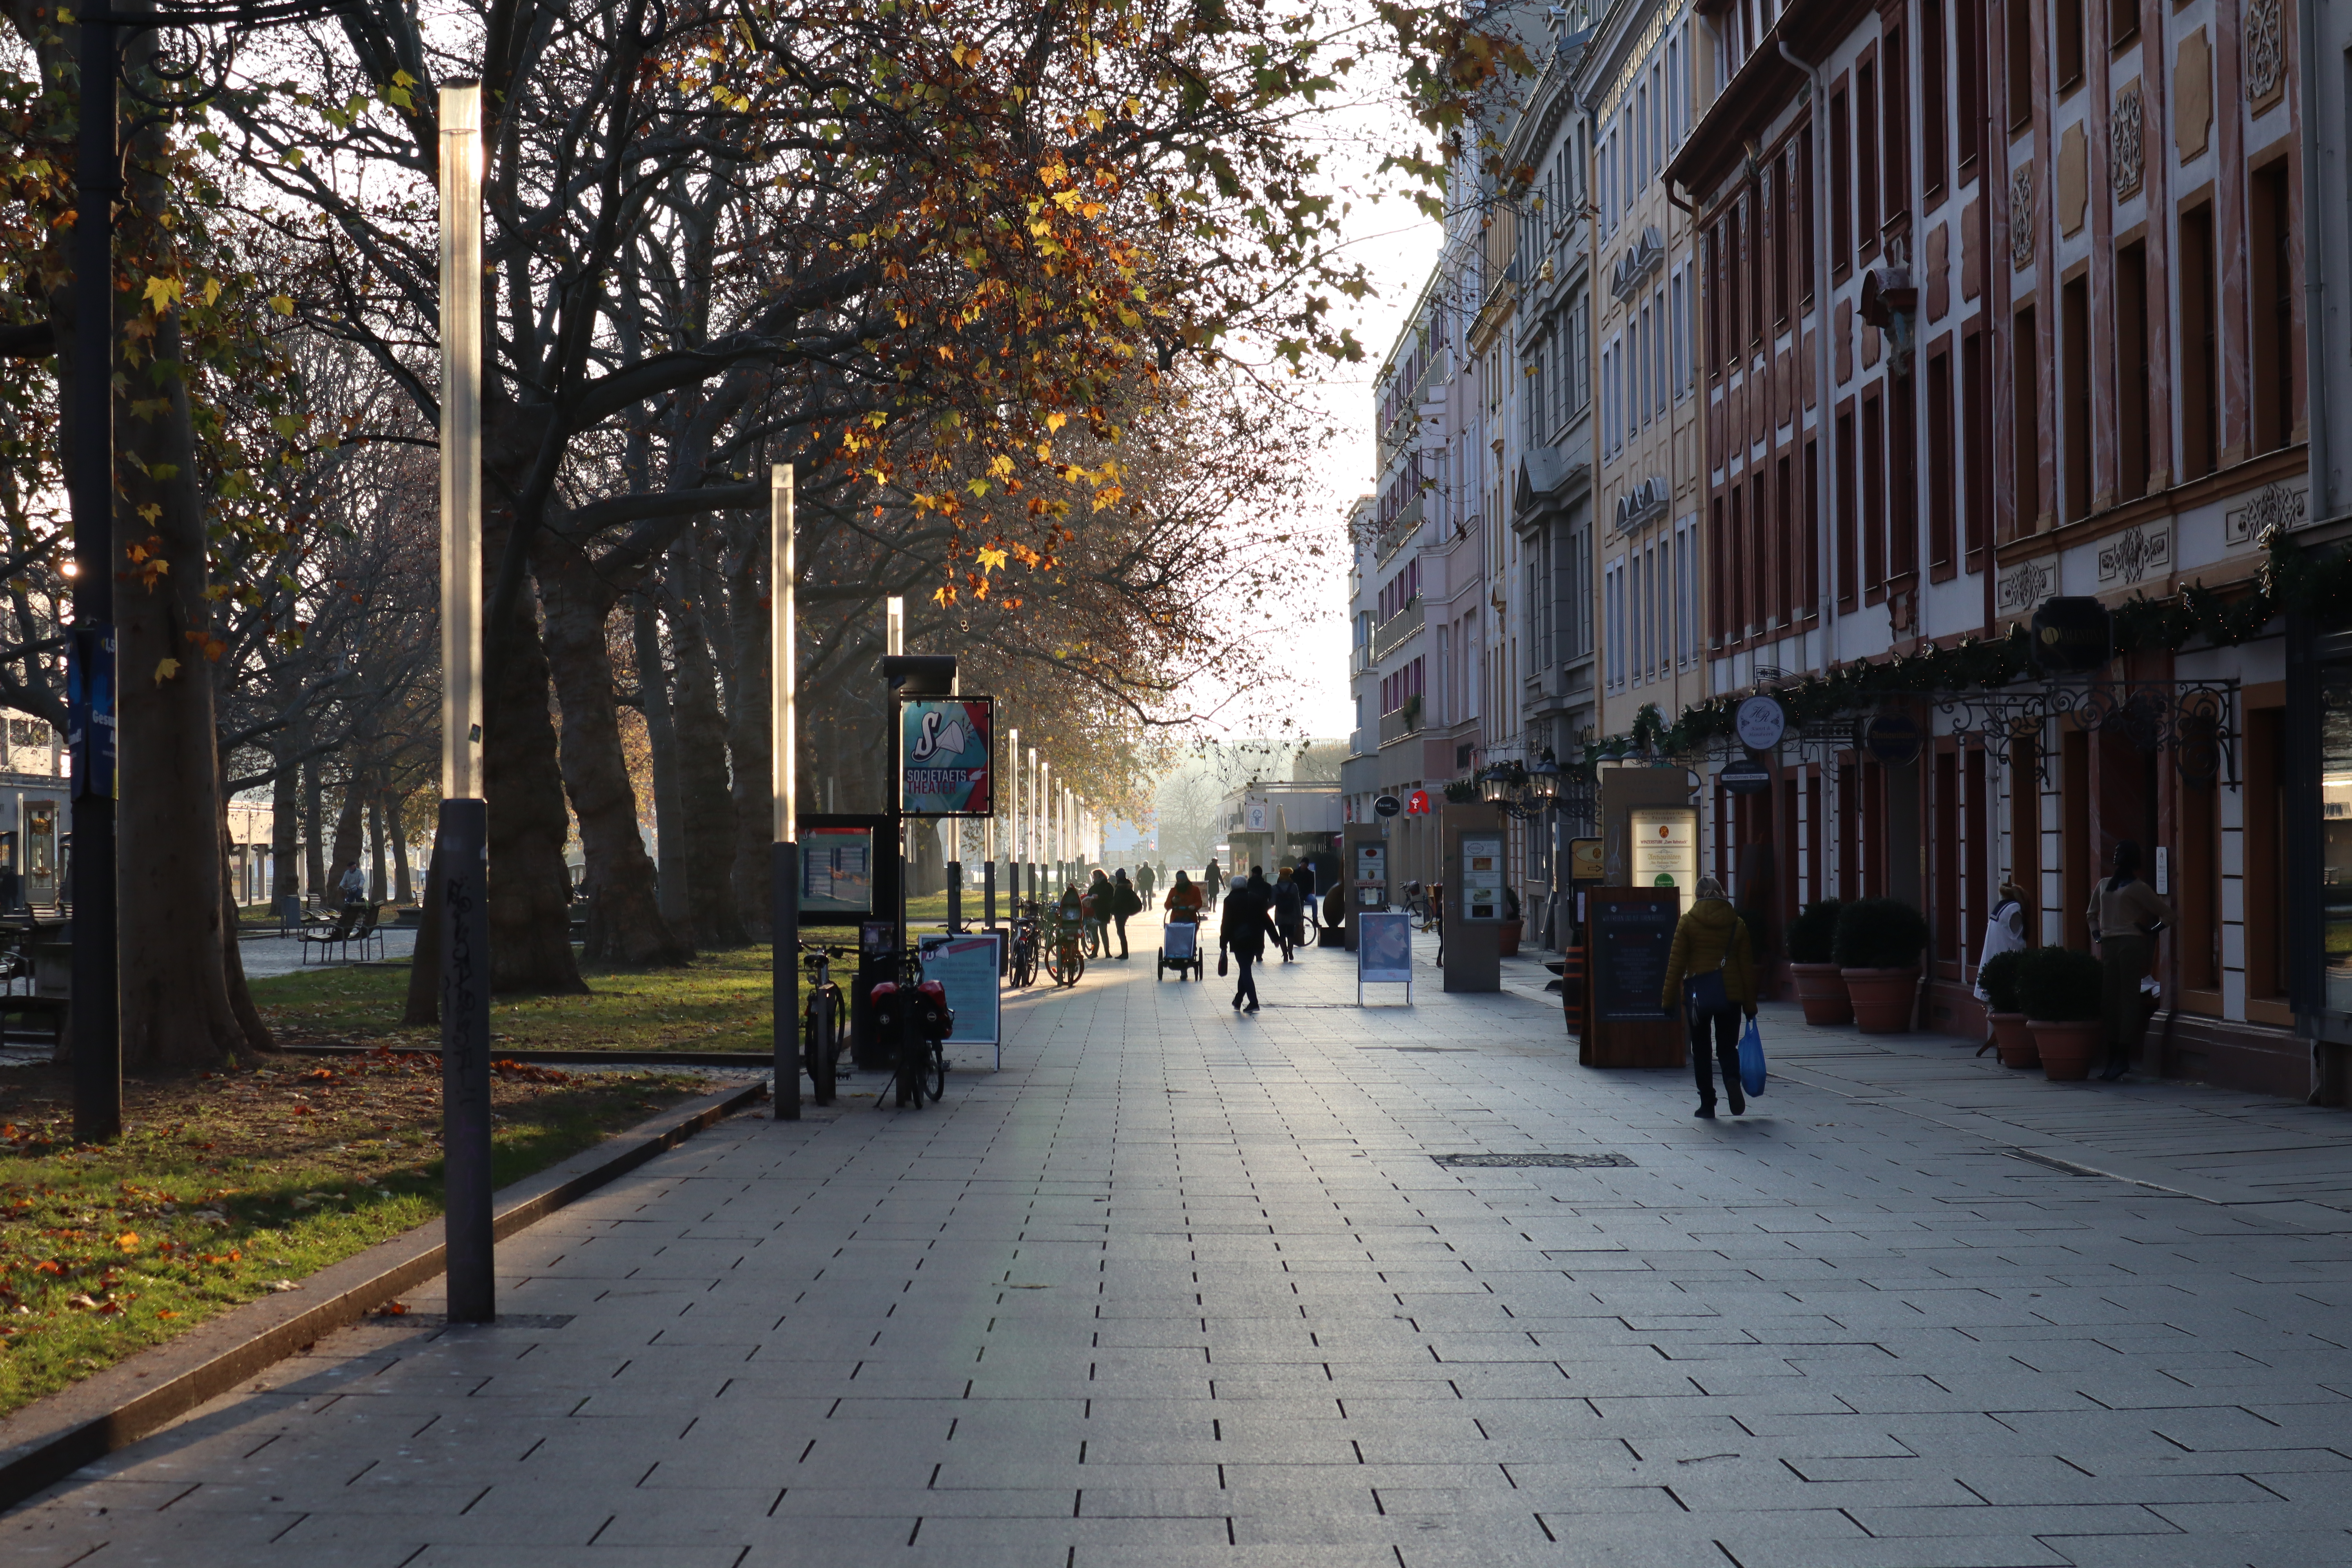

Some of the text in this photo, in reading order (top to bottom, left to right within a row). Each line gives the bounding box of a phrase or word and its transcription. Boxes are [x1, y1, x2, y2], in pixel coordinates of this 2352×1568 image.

[1872, 731, 1916, 740] Antiquitäten
[907, 770, 966, 782] SOCIETAETS
[907, 781, 956, 794] THEATER
